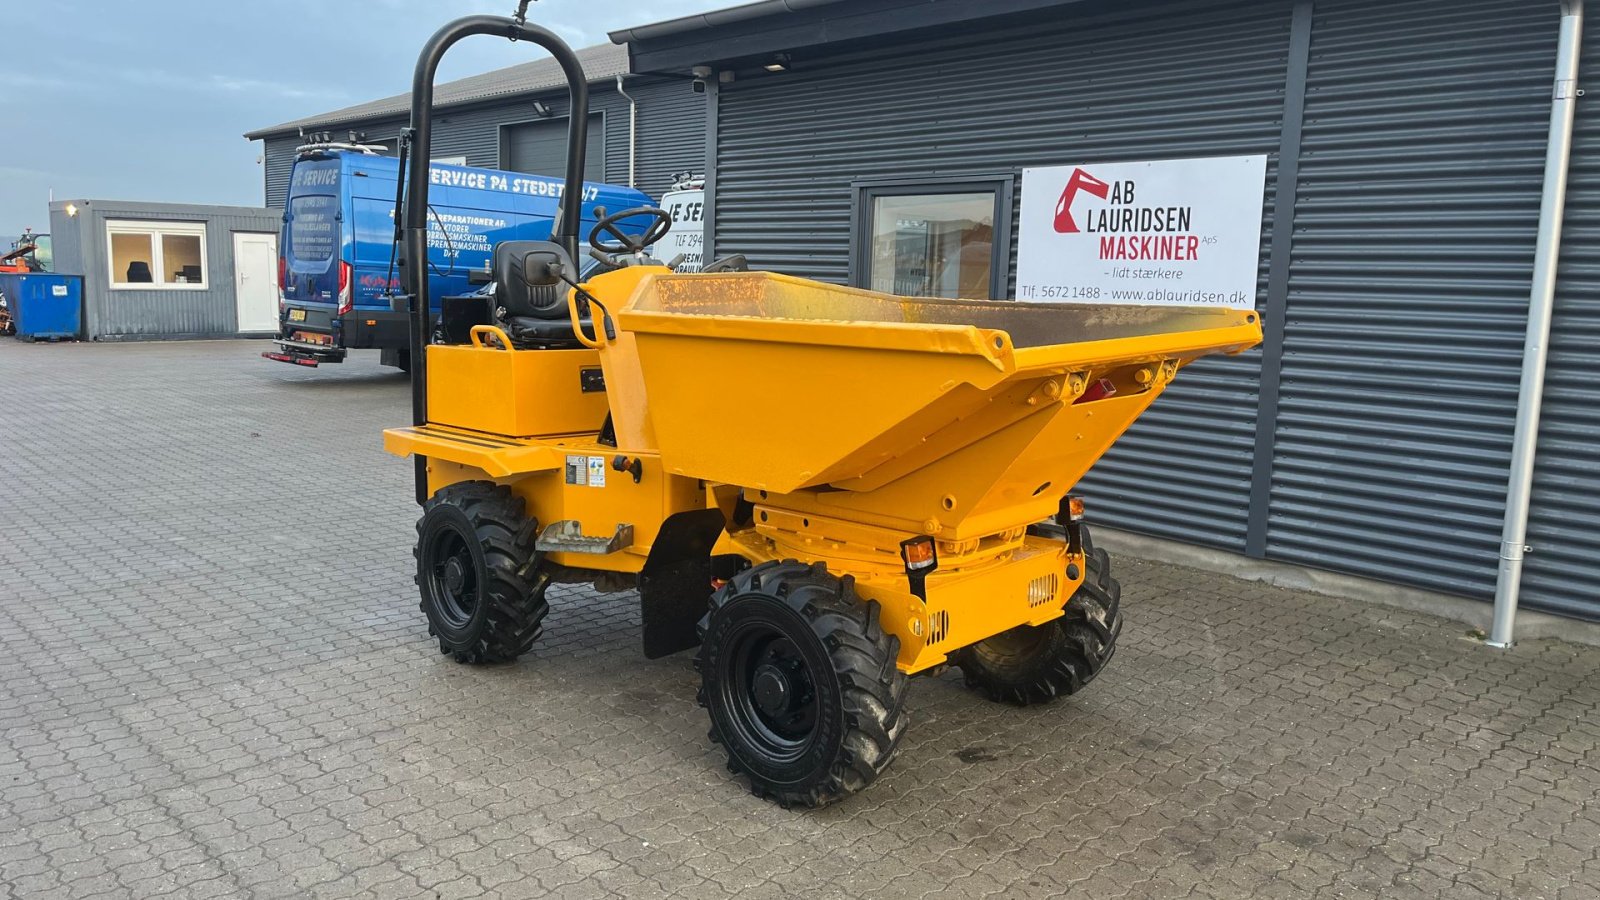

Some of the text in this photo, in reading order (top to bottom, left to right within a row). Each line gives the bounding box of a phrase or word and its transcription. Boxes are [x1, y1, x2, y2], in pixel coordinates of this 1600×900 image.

[303, 168, 339, 186] SERVICE
[428, 168, 487, 189] ERVICE
[490, 174, 508, 191] PÅ
[513, 179, 565, 198] STEDET
[1111, 180, 1135, 205] AB
[438, 214, 493, 227] REPARATIONER
[1087, 207, 1191, 233] LAURIDSEN
[427, 231, 488, 243] DBRUSMASKINER
[675, 234, 687, 247] TLF
[427, 239, 492, 252] EPRENRMASKINER
[1099, 235, 1218, 261] MASKINER ApS
[683, 253, 703, 263] RESNI
[1112, 267, 1130, 278] lidt
[1132, 267, 1183, 280] stærkere
[1022, 285, 1038, 299] Tlf.
[1041, 286, 1069, 298] 5672
[1072, 287, 1101, 299] 1488
[1112, 288, 1247, 304] www.ablauridsen.dk
